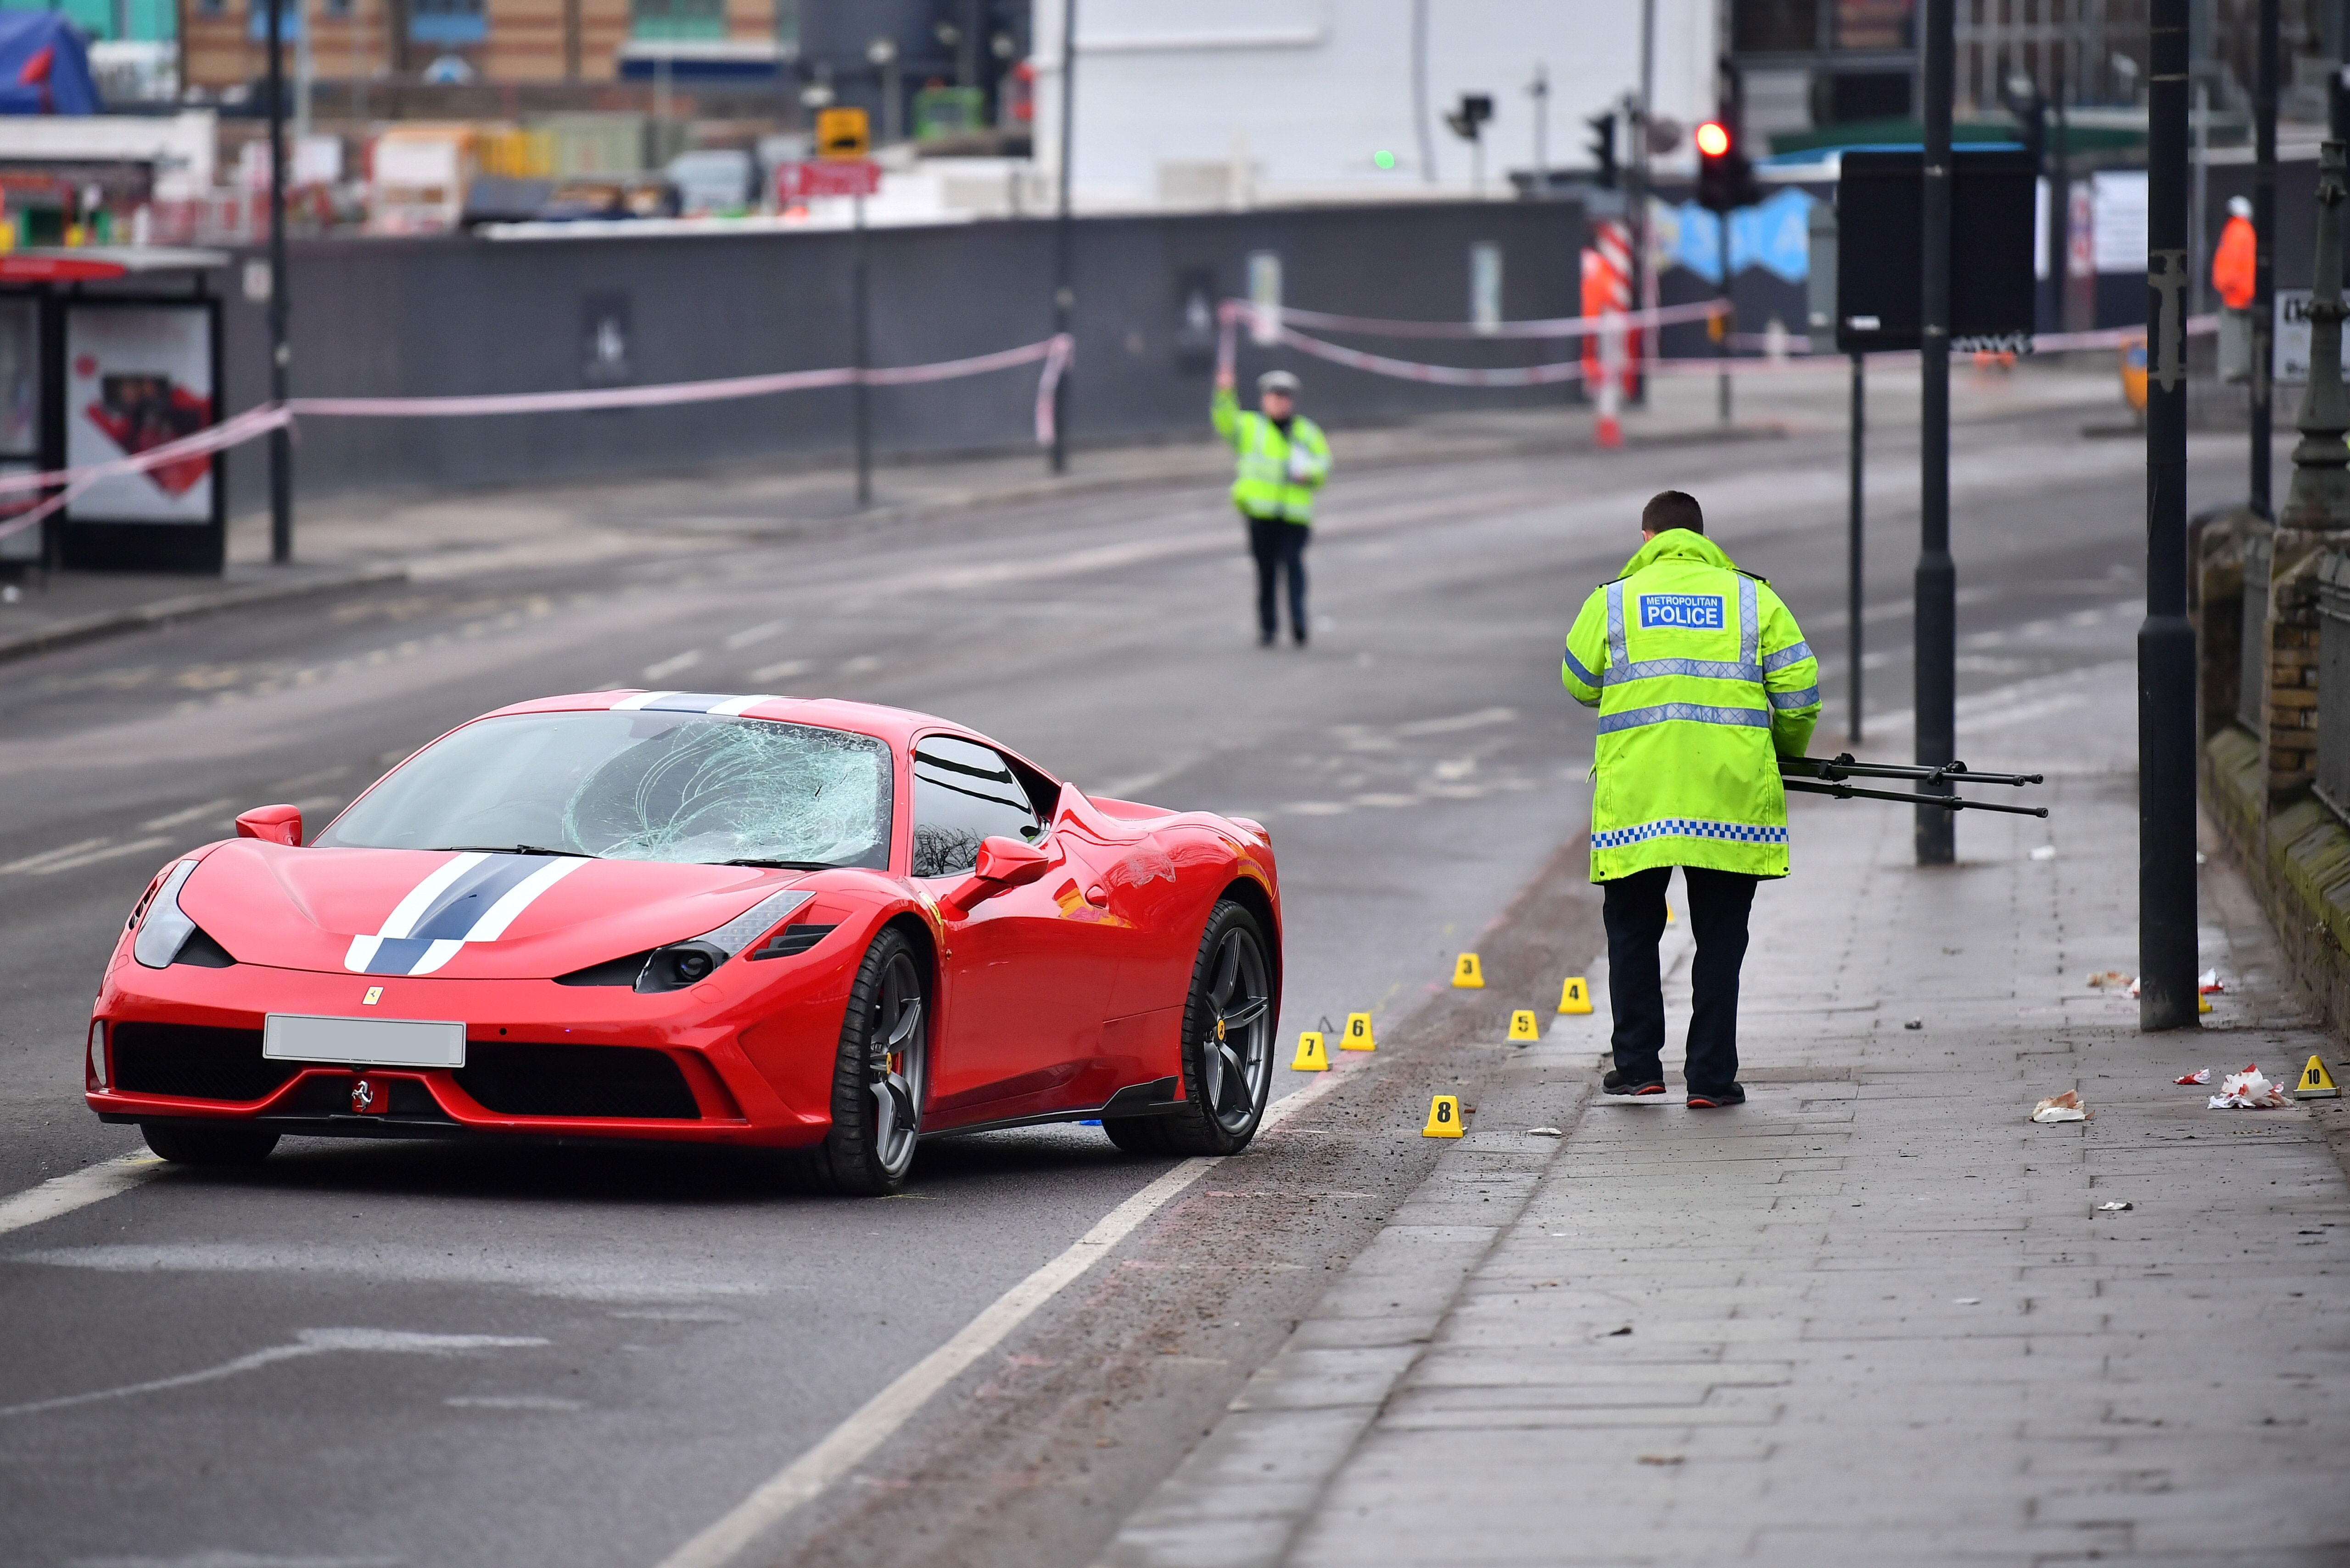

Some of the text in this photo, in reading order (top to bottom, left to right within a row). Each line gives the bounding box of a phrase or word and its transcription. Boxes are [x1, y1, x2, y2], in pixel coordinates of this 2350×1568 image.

[1646, 597, 1718, 606] METROPOLITAN
[1648, 606, 1718, 625] POLICE
[1464, 960, 1472, 974] 3
[1569, 985, 1579, 1000] 4
[1353, 1019, 1364, 1036] 6
[1518, 1016, 1528, 1032] 5
[1306, 1039, 1315, 1056] 7
[2307, 1069, 2320, 1084] 10
[1437, 1102, 1451, 1123] 8
